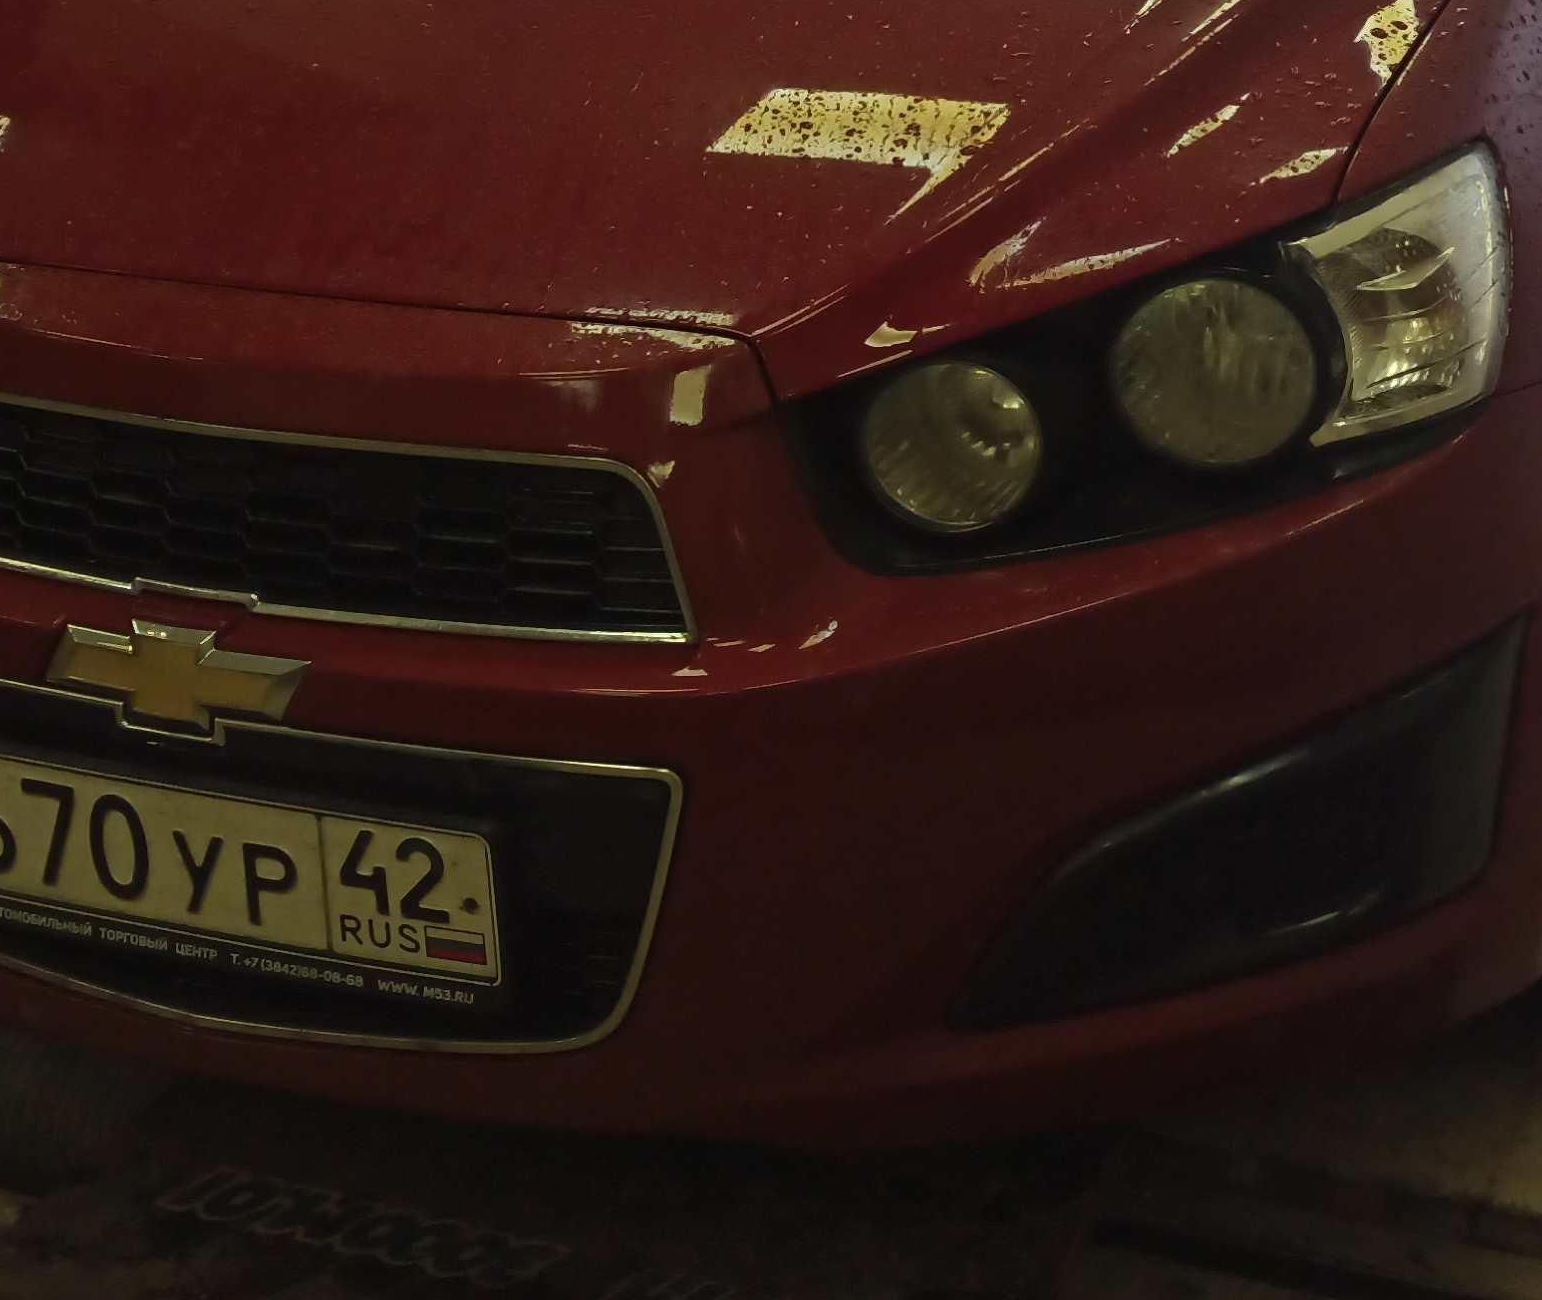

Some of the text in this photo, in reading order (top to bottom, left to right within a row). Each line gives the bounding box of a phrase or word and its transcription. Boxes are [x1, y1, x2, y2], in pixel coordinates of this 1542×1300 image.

[339, 829, 450, 925] 42
[99, 926, 169, 951] ТОРГОВЫЙ
[175, 941, 219, 961] ЦЕНТР
[340, 914, 422, 954] RUS
